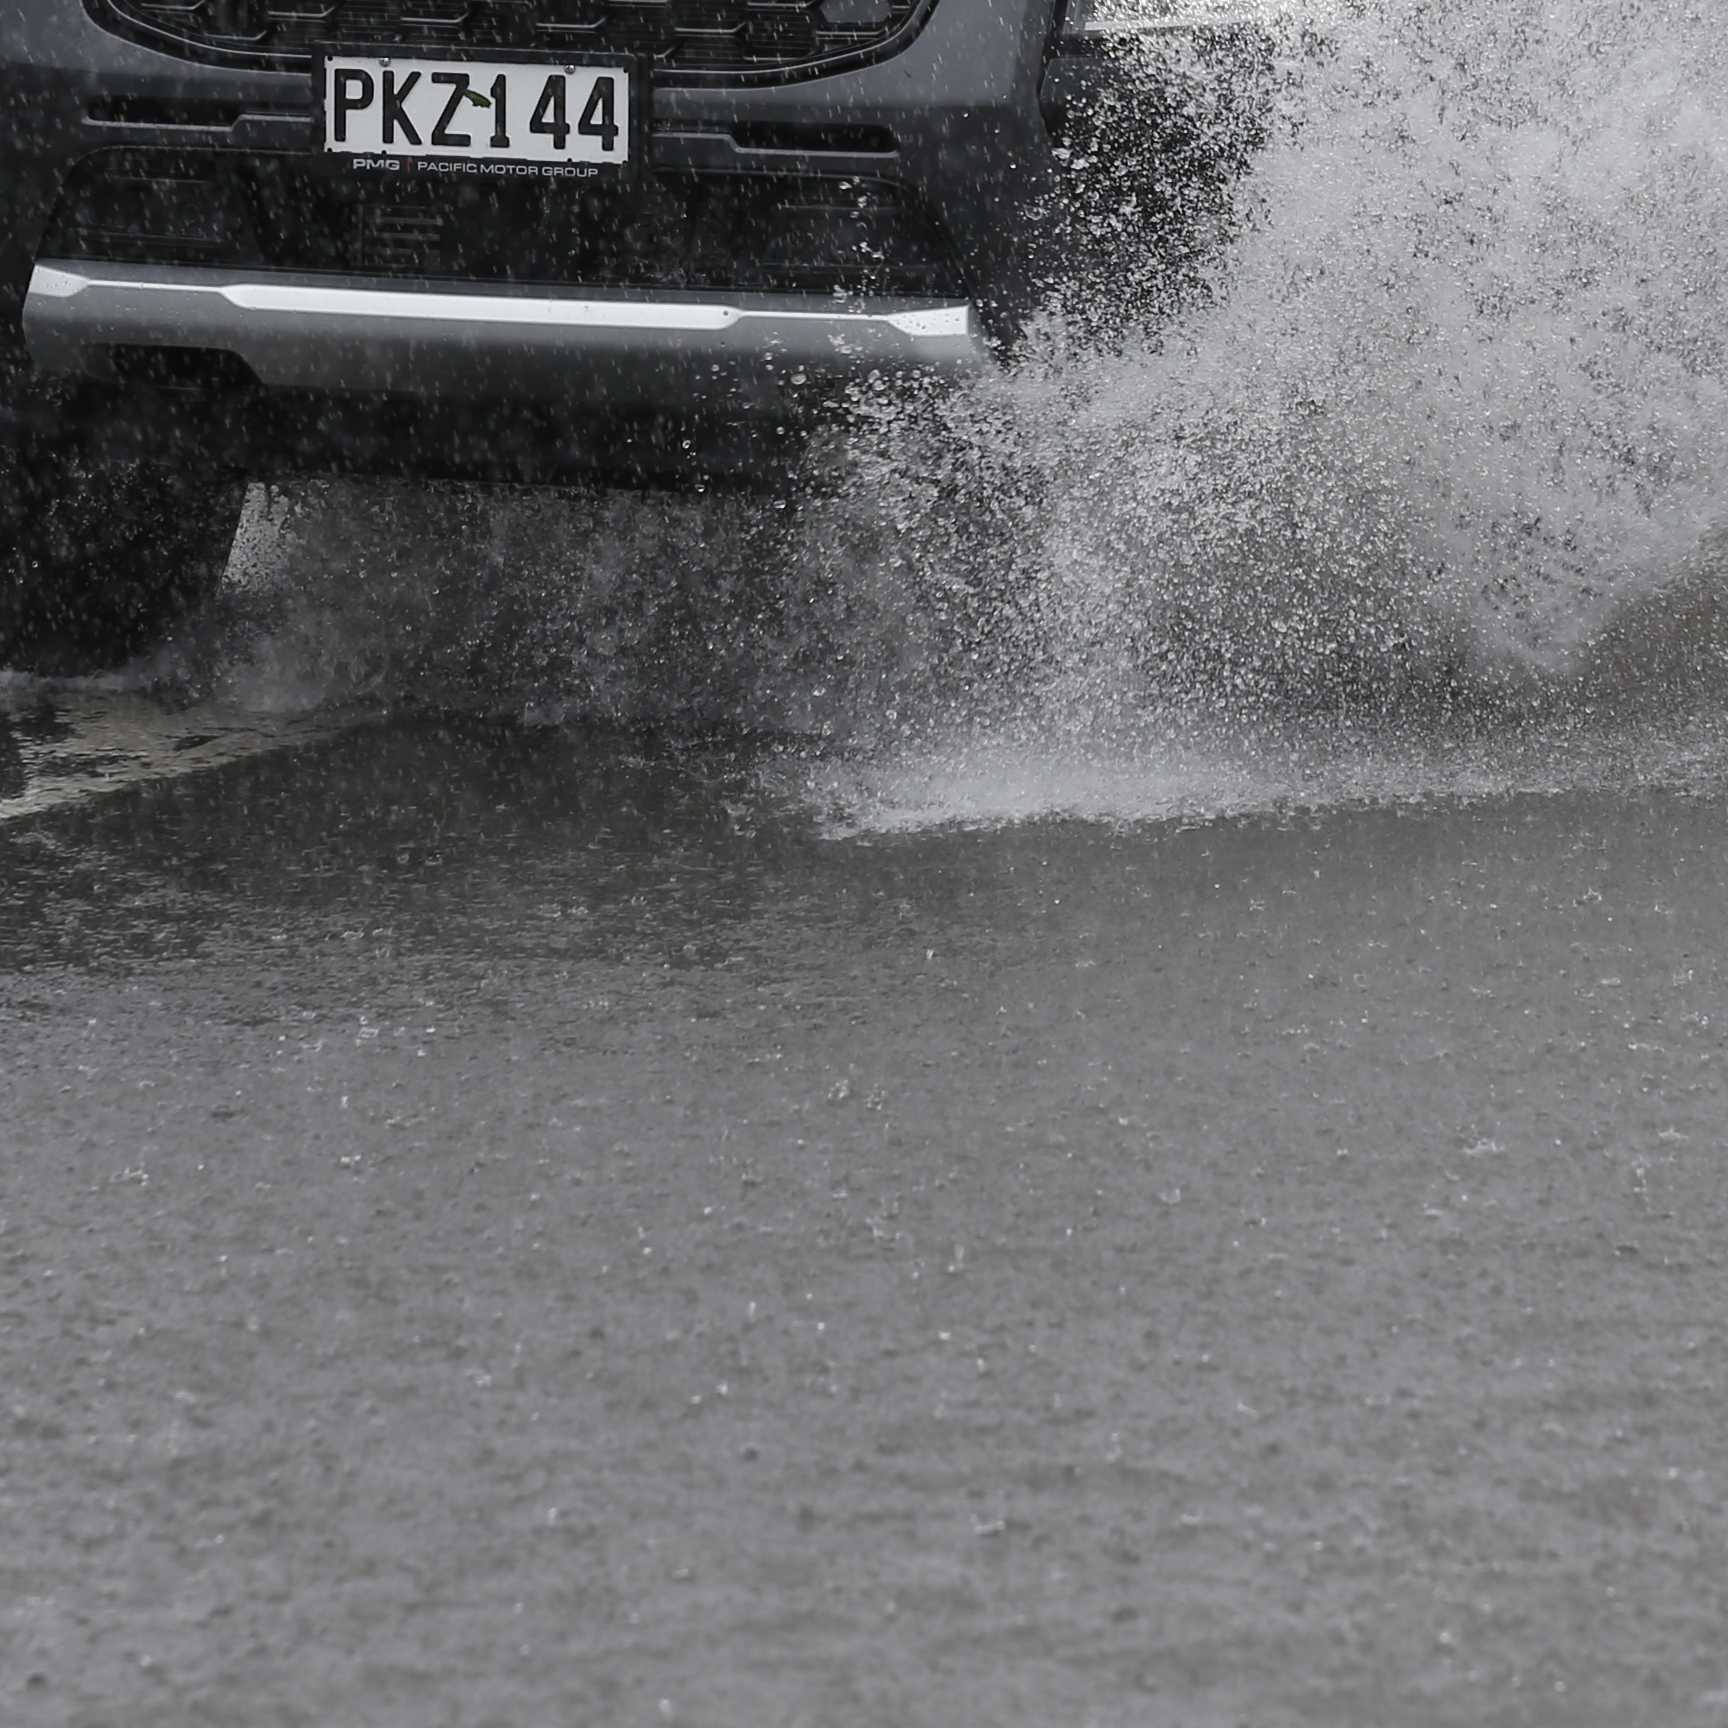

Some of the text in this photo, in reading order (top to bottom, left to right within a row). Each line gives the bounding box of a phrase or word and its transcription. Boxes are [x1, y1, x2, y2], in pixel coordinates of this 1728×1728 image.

[334, 68, 619, 152] PKZ144
[353, 158, 400, 171] PMG
[417, 160, 599, 178] PACIFIC MOTOR GROUP
